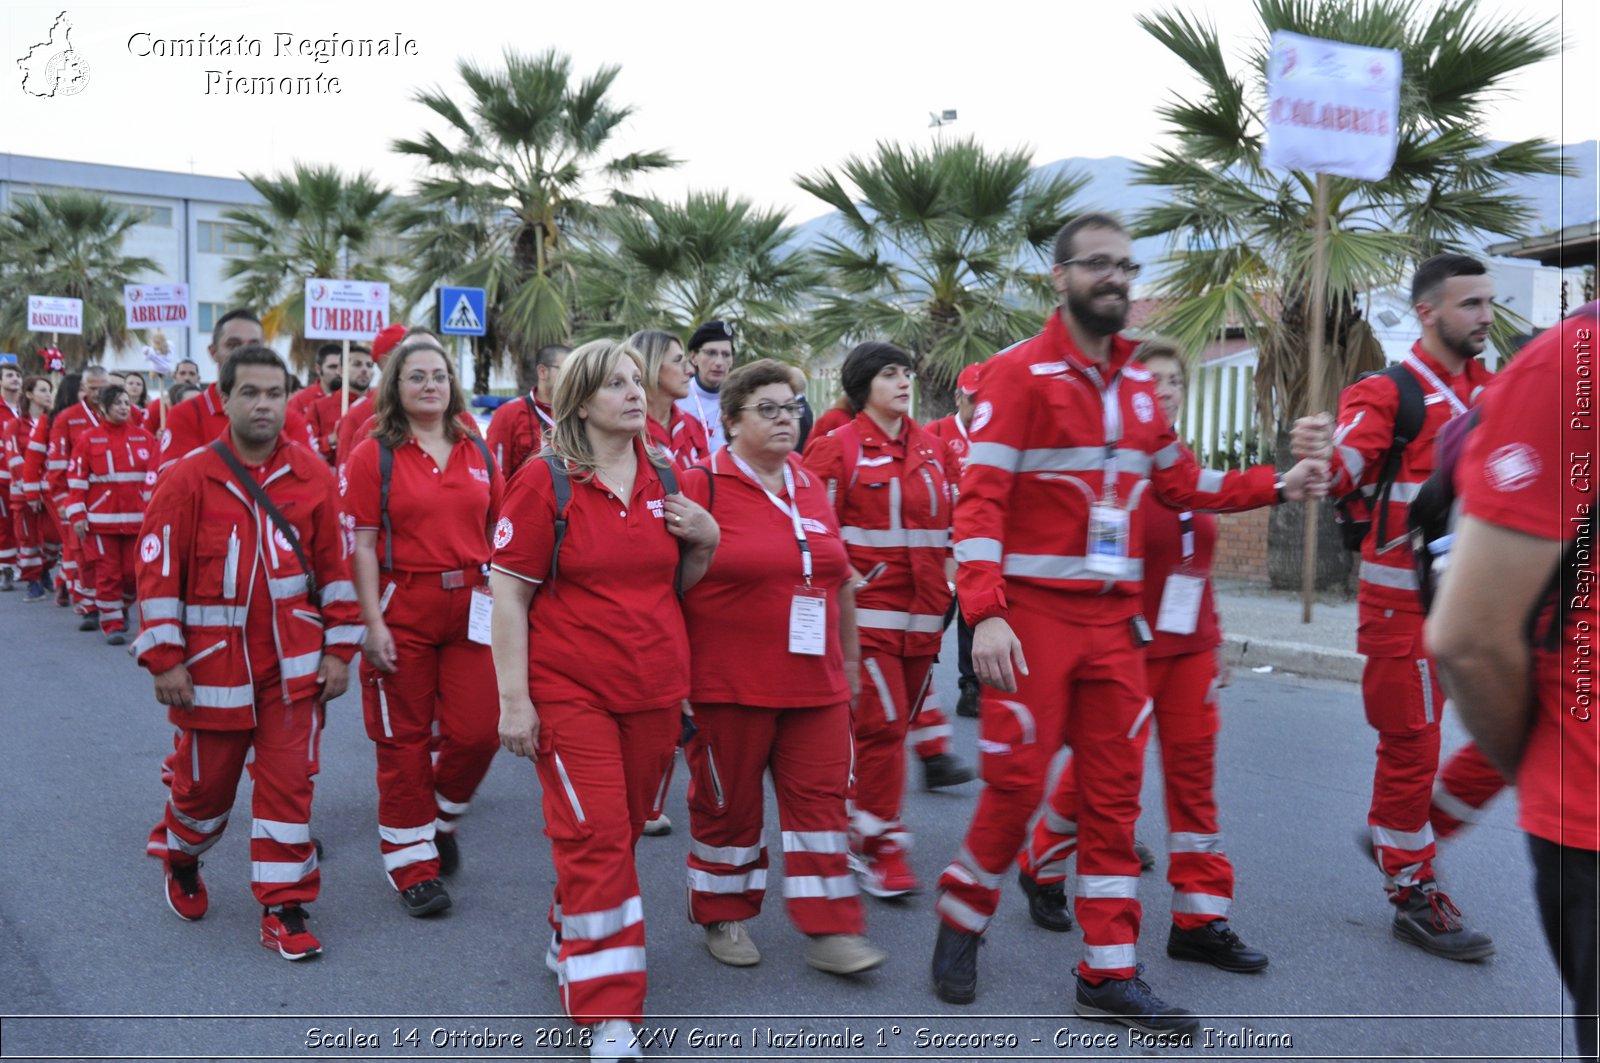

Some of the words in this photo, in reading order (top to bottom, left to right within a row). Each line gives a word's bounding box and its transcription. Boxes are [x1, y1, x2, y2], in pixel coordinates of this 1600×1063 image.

[31, 312, 79, 328] BASILICATA
[131, 304, 187, 323] ABRUZZO
[311, 307, 384, 332] UMBRIA
